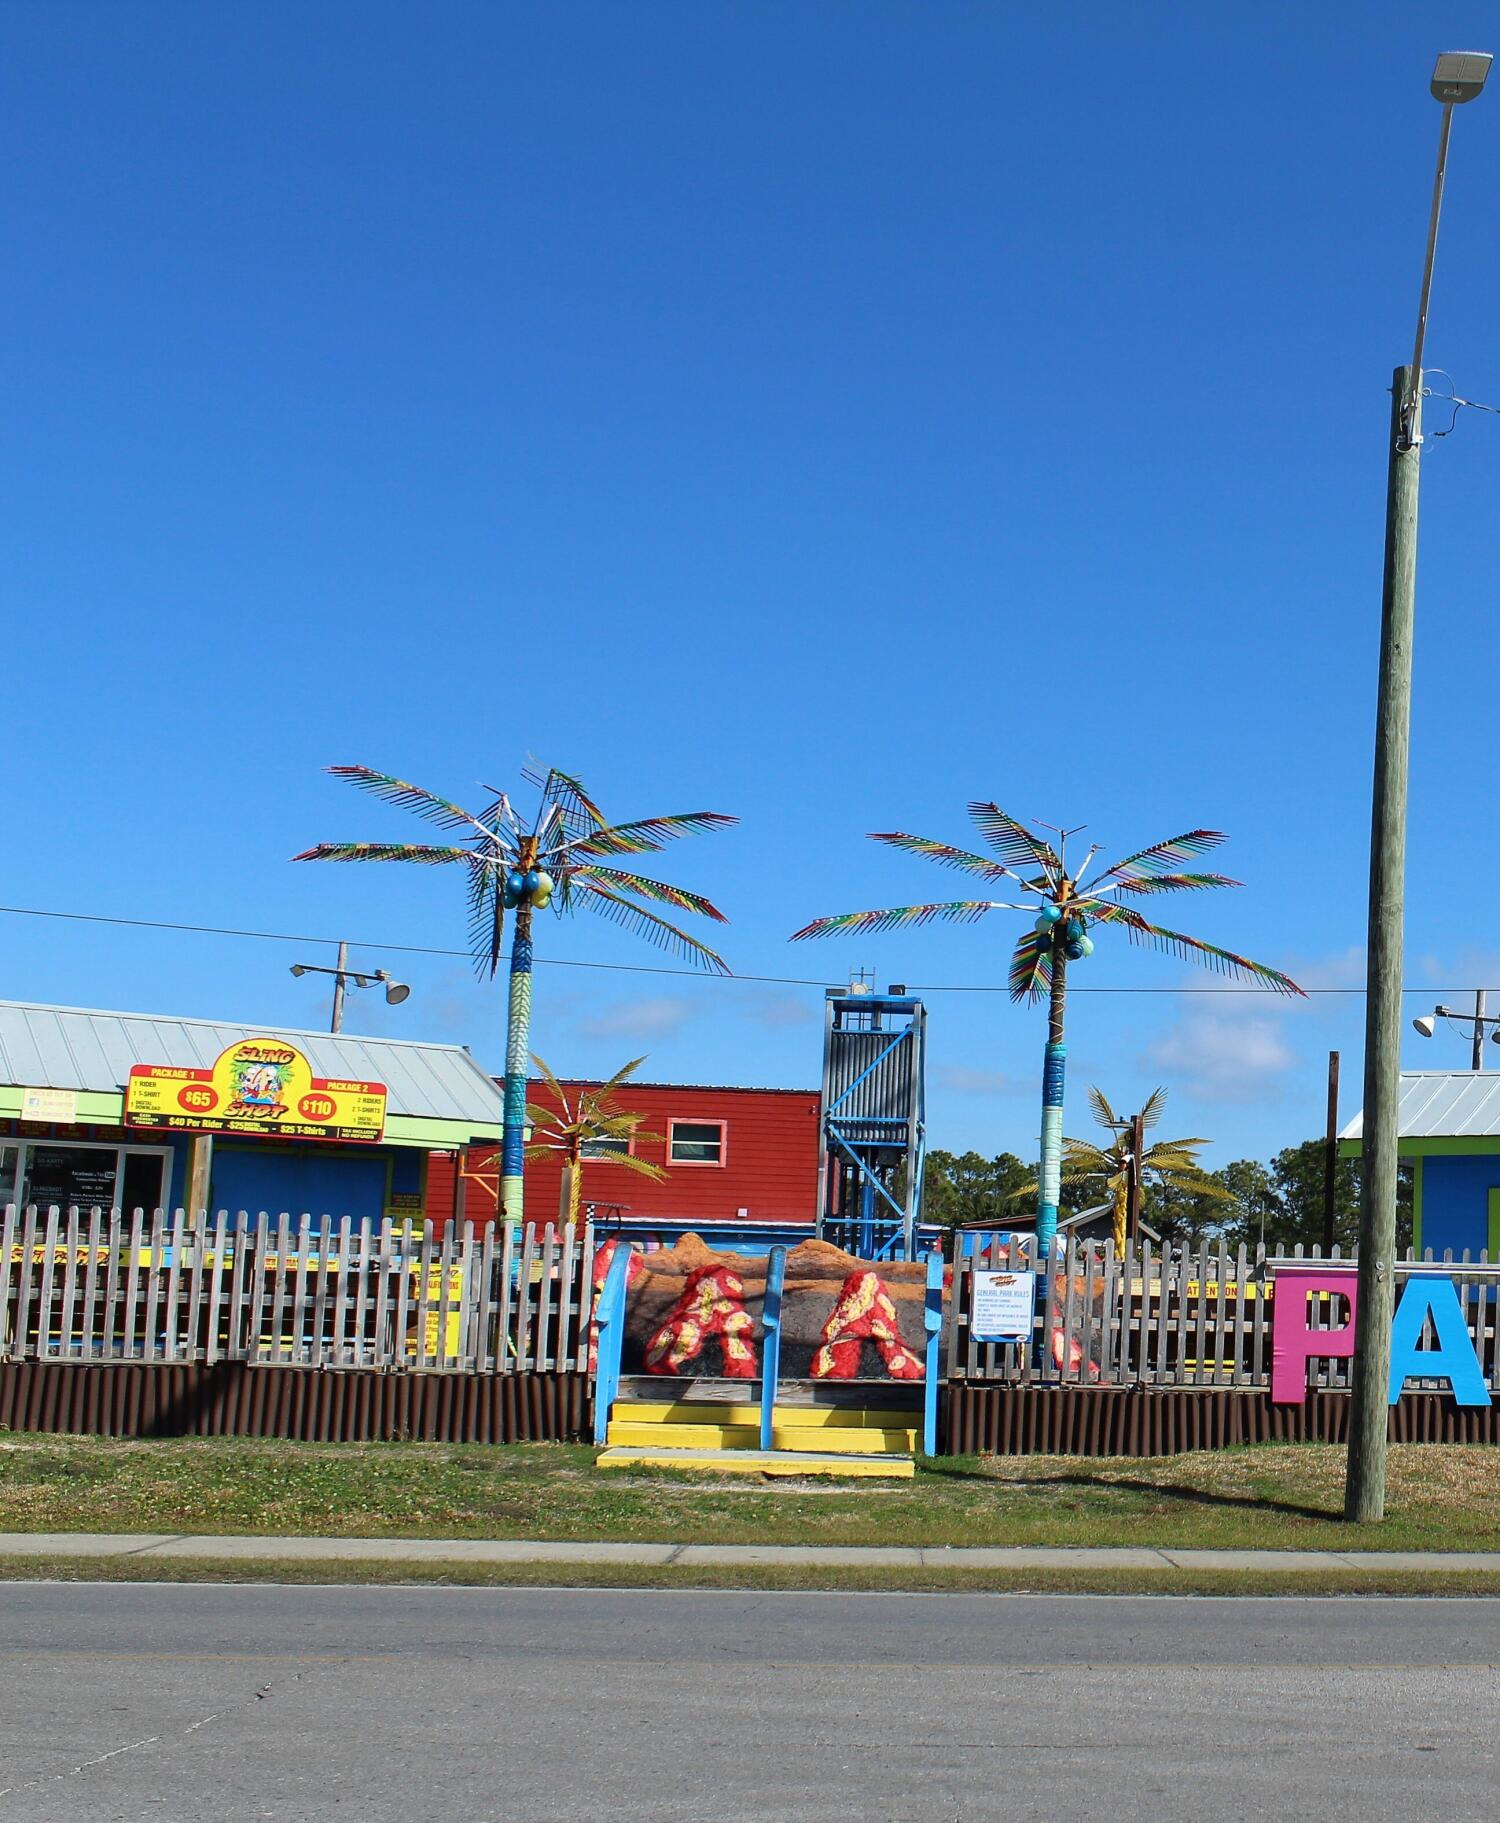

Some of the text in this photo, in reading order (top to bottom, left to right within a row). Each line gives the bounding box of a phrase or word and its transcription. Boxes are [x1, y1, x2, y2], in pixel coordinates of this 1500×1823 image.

[150, 1068, 195, 1079] PACKAGE 1
[327, 1081, 369, 1092] PACKAGE 2
[185, 1090, 211, 1107] $65
[223, 1101, 289, 1119] SHOT
[302, 1099, 332, 1115] $110
[169, 1117, 186, 1126] $40
[186, 1118, 201, 1127] Per
[202, 1119, 224, 1129] Rider
[280, 1124, 296, 1133] $25
[297, 1126, 327, 1136] T-Shirts
[1187, 1286, 1238, 1296] ATENON
